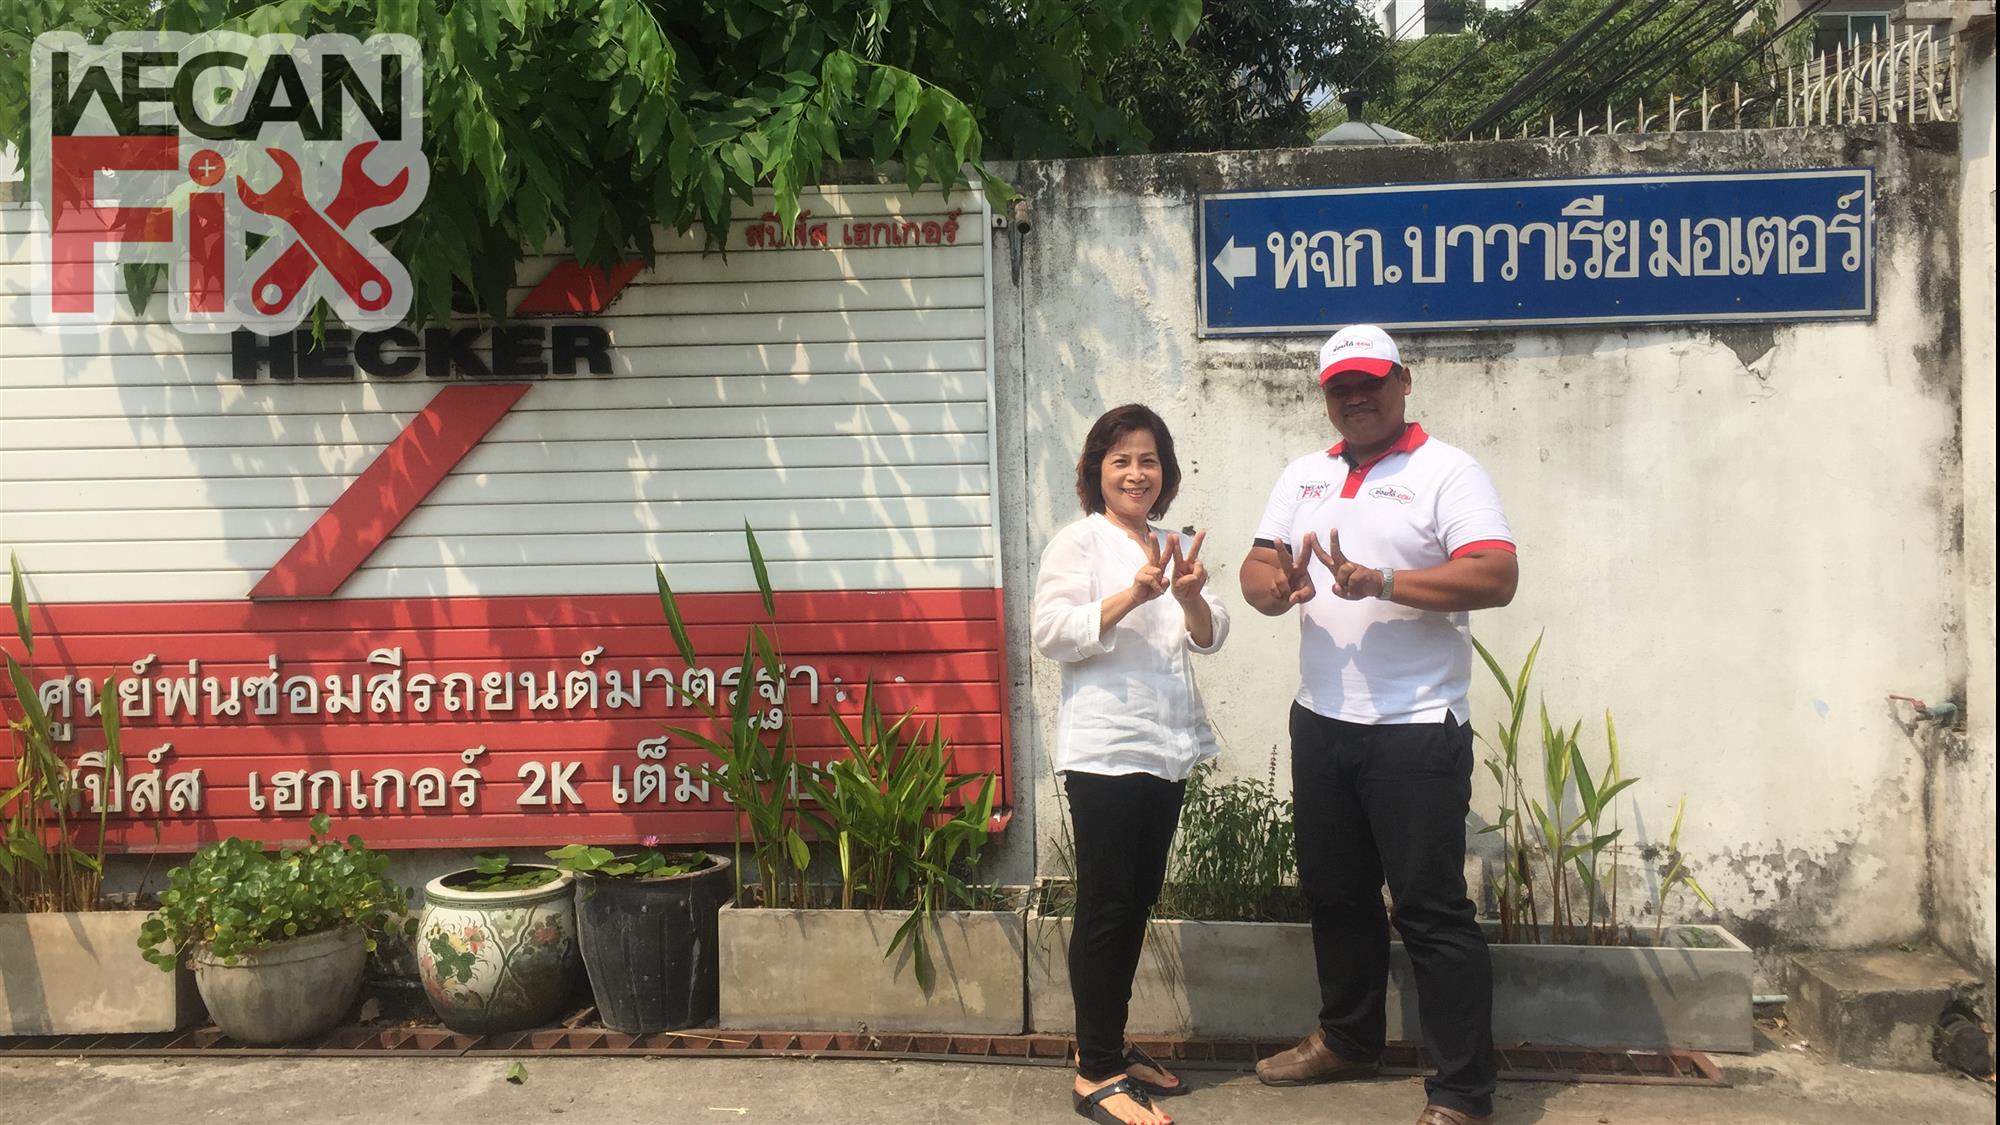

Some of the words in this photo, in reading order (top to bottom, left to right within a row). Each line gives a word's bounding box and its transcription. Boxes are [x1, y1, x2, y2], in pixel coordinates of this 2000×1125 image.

[843, 208, 962, 246] เฮกเกอร์
[1648, 189, 1864, 277] มอเตอร์
[231, 325, 614, 380] HECKER
[248, 743, 487, 811] เฮกเกอร์
[516, 760, 584, 805] 2K
